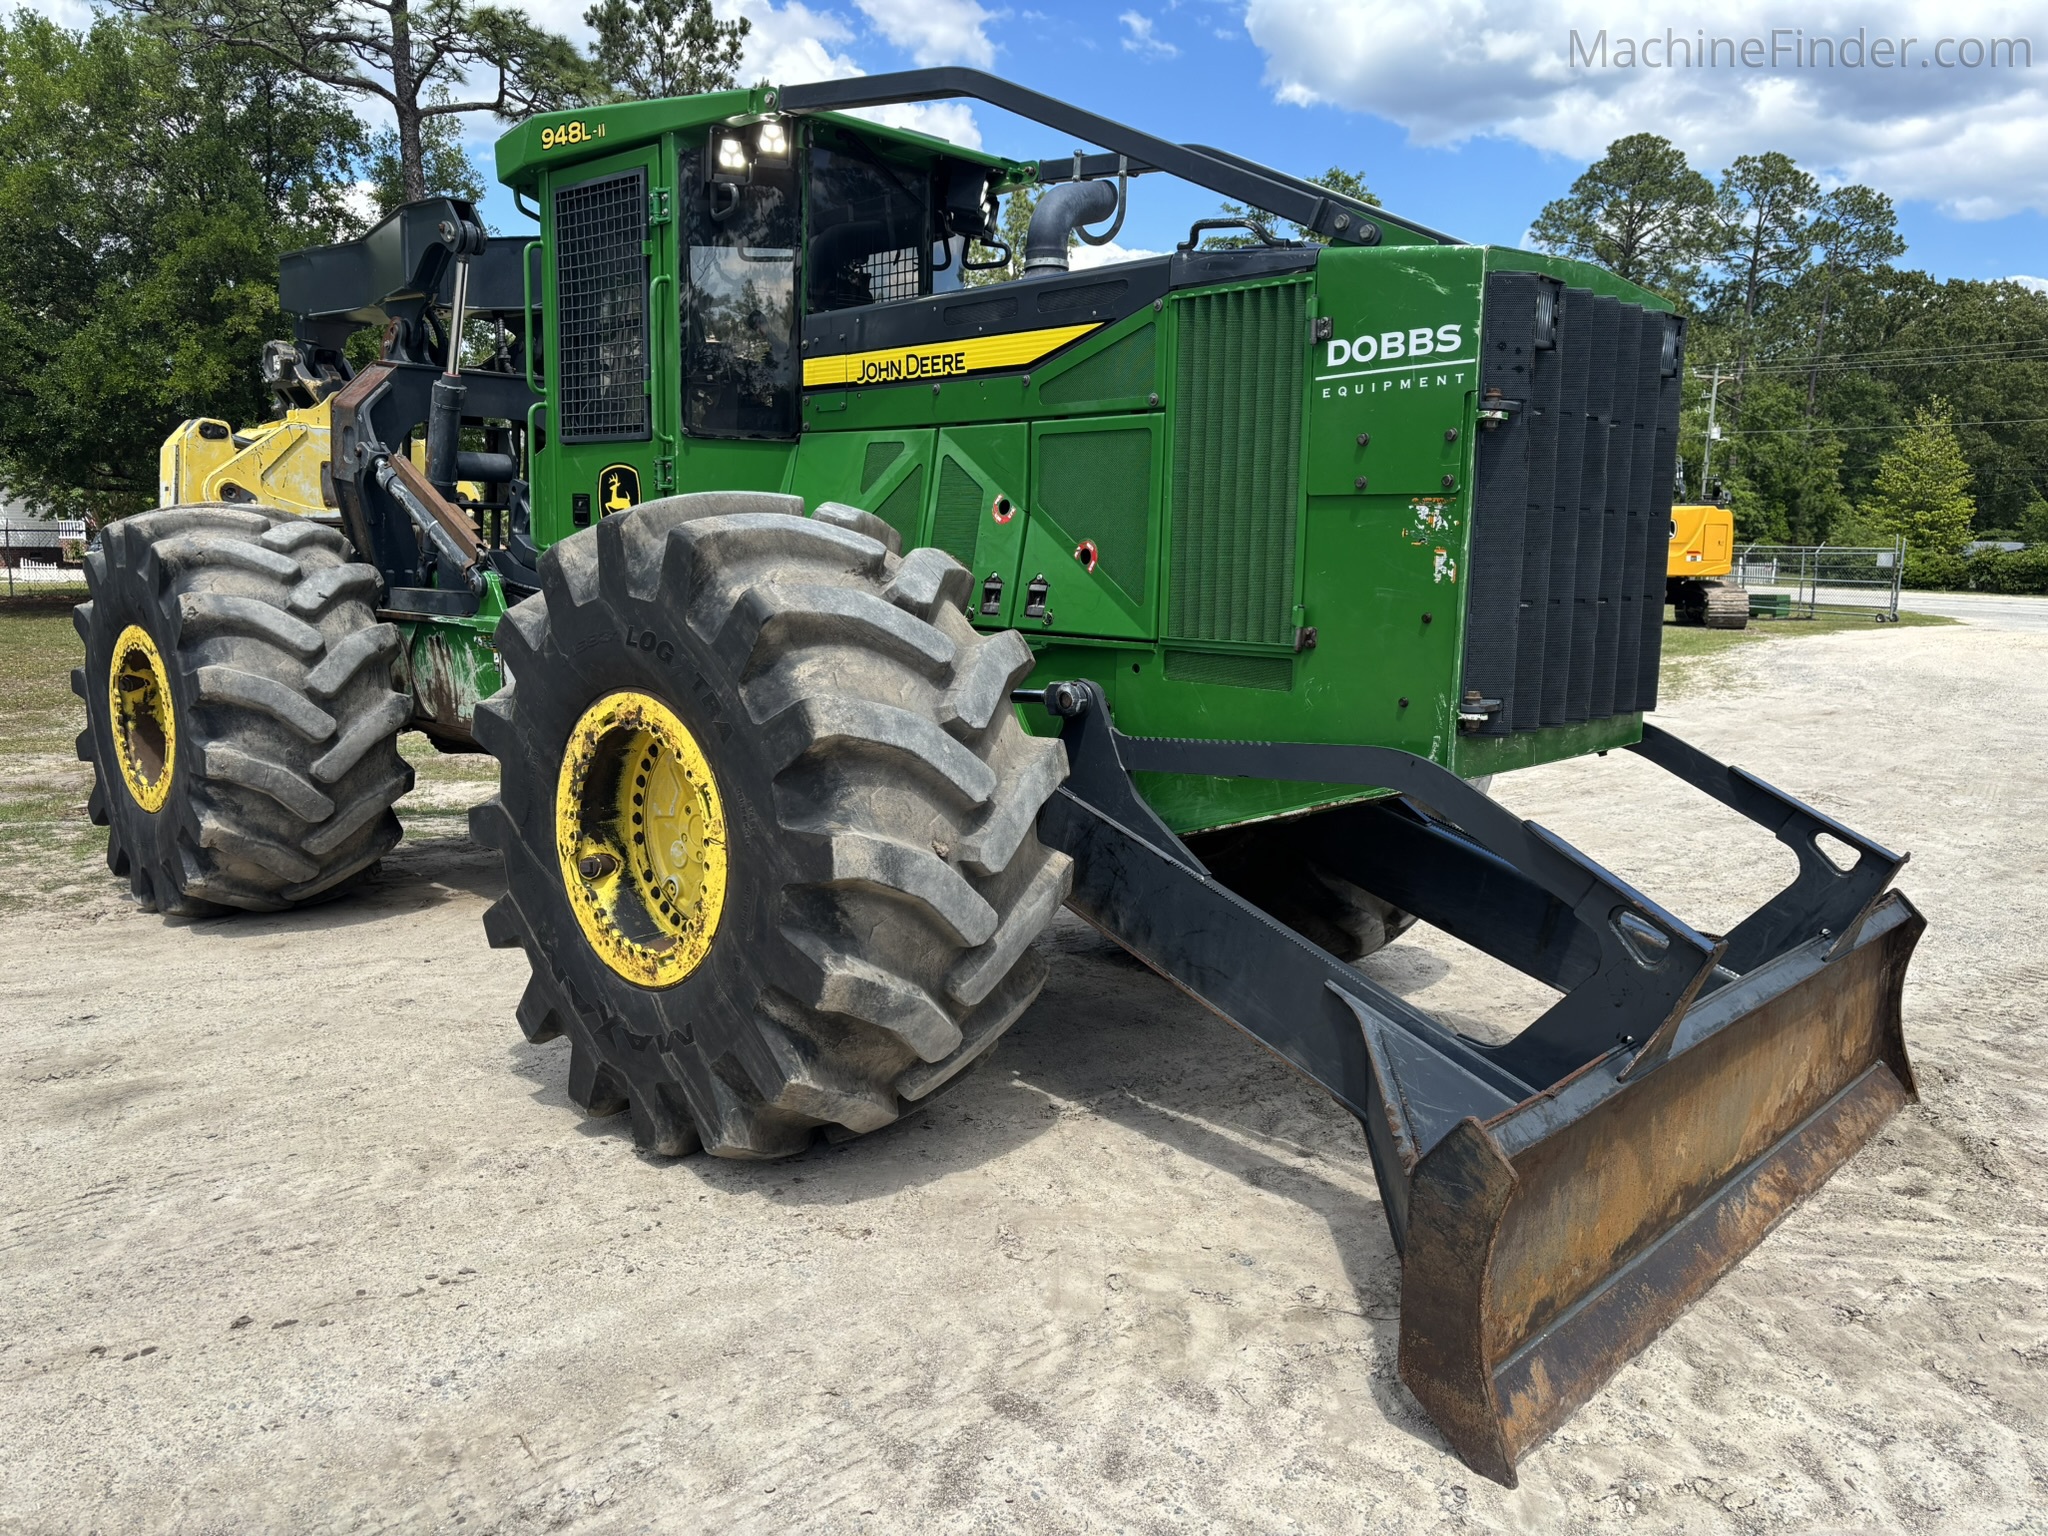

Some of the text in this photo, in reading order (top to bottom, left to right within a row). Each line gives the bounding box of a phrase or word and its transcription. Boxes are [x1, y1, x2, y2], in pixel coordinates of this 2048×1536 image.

[1326, 324, 1462, 367] DOBBS
[857, 352, 966, 382] JOHN DEERE
[1322, 372, 1465, 399] EQUIPMENT
